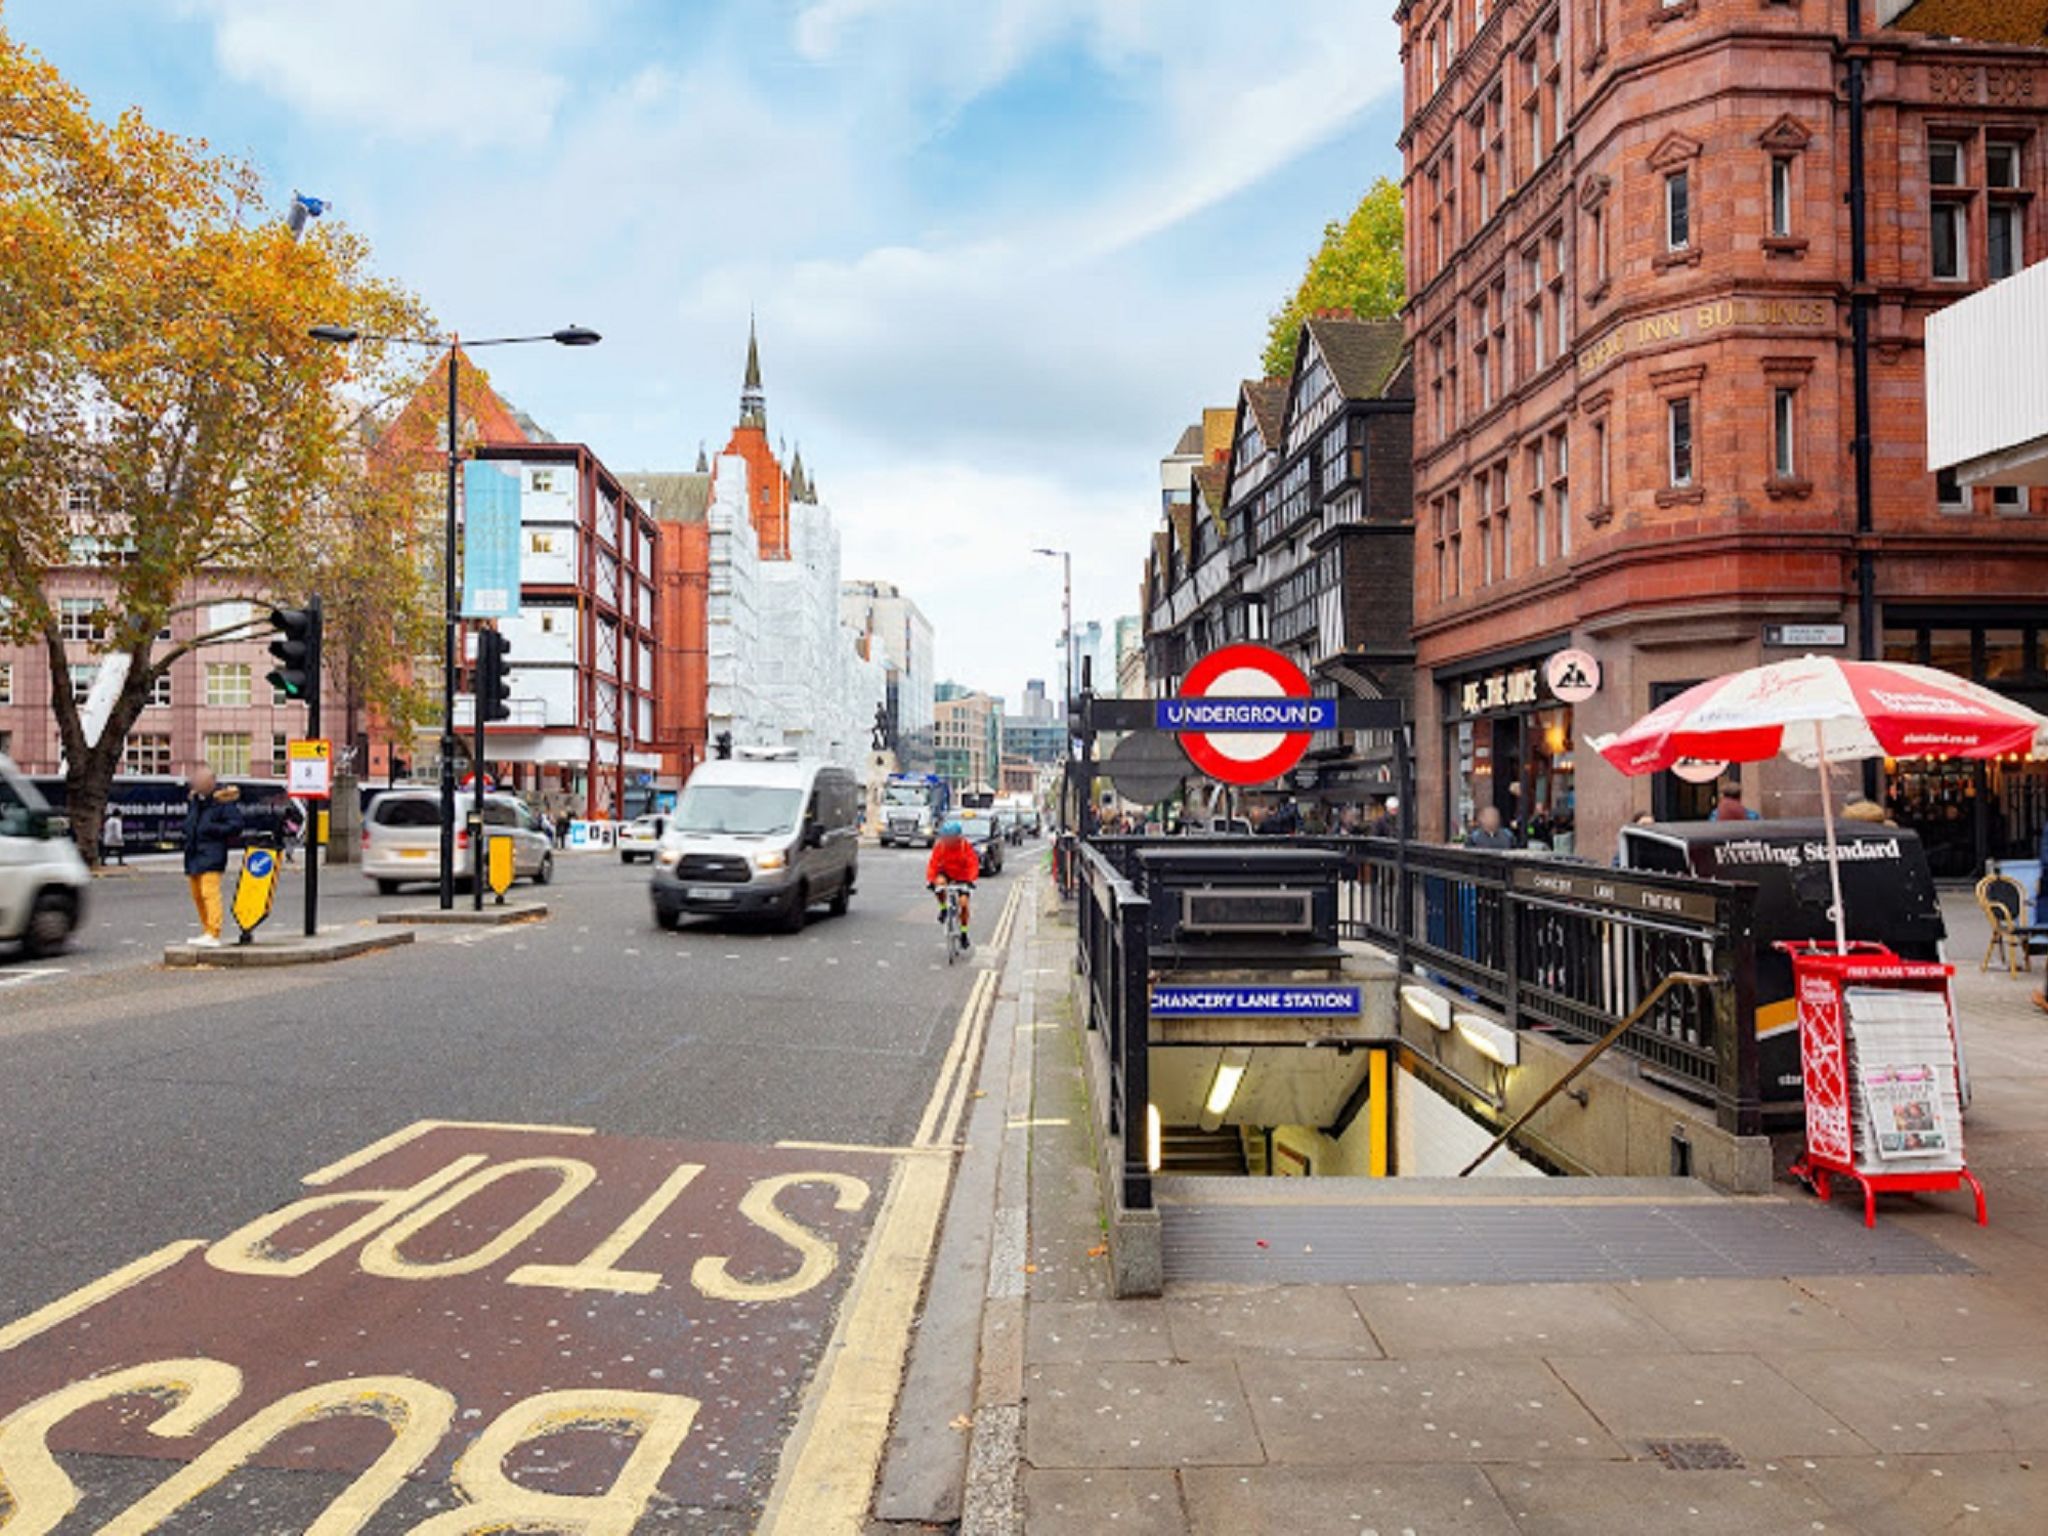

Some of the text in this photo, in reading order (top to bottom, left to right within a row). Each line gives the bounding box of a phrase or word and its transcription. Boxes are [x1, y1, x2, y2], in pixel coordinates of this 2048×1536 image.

[1637, 315, 1682, 345] INN
[1167, 705, 1323, 724] UNDERGROUND
[1714, 837, 1902, 867] Evening Stndard
[1150, 993, 1352, 1008] CHANCERY LANE STATION
[204, 1153, 869, 1302] STOP
